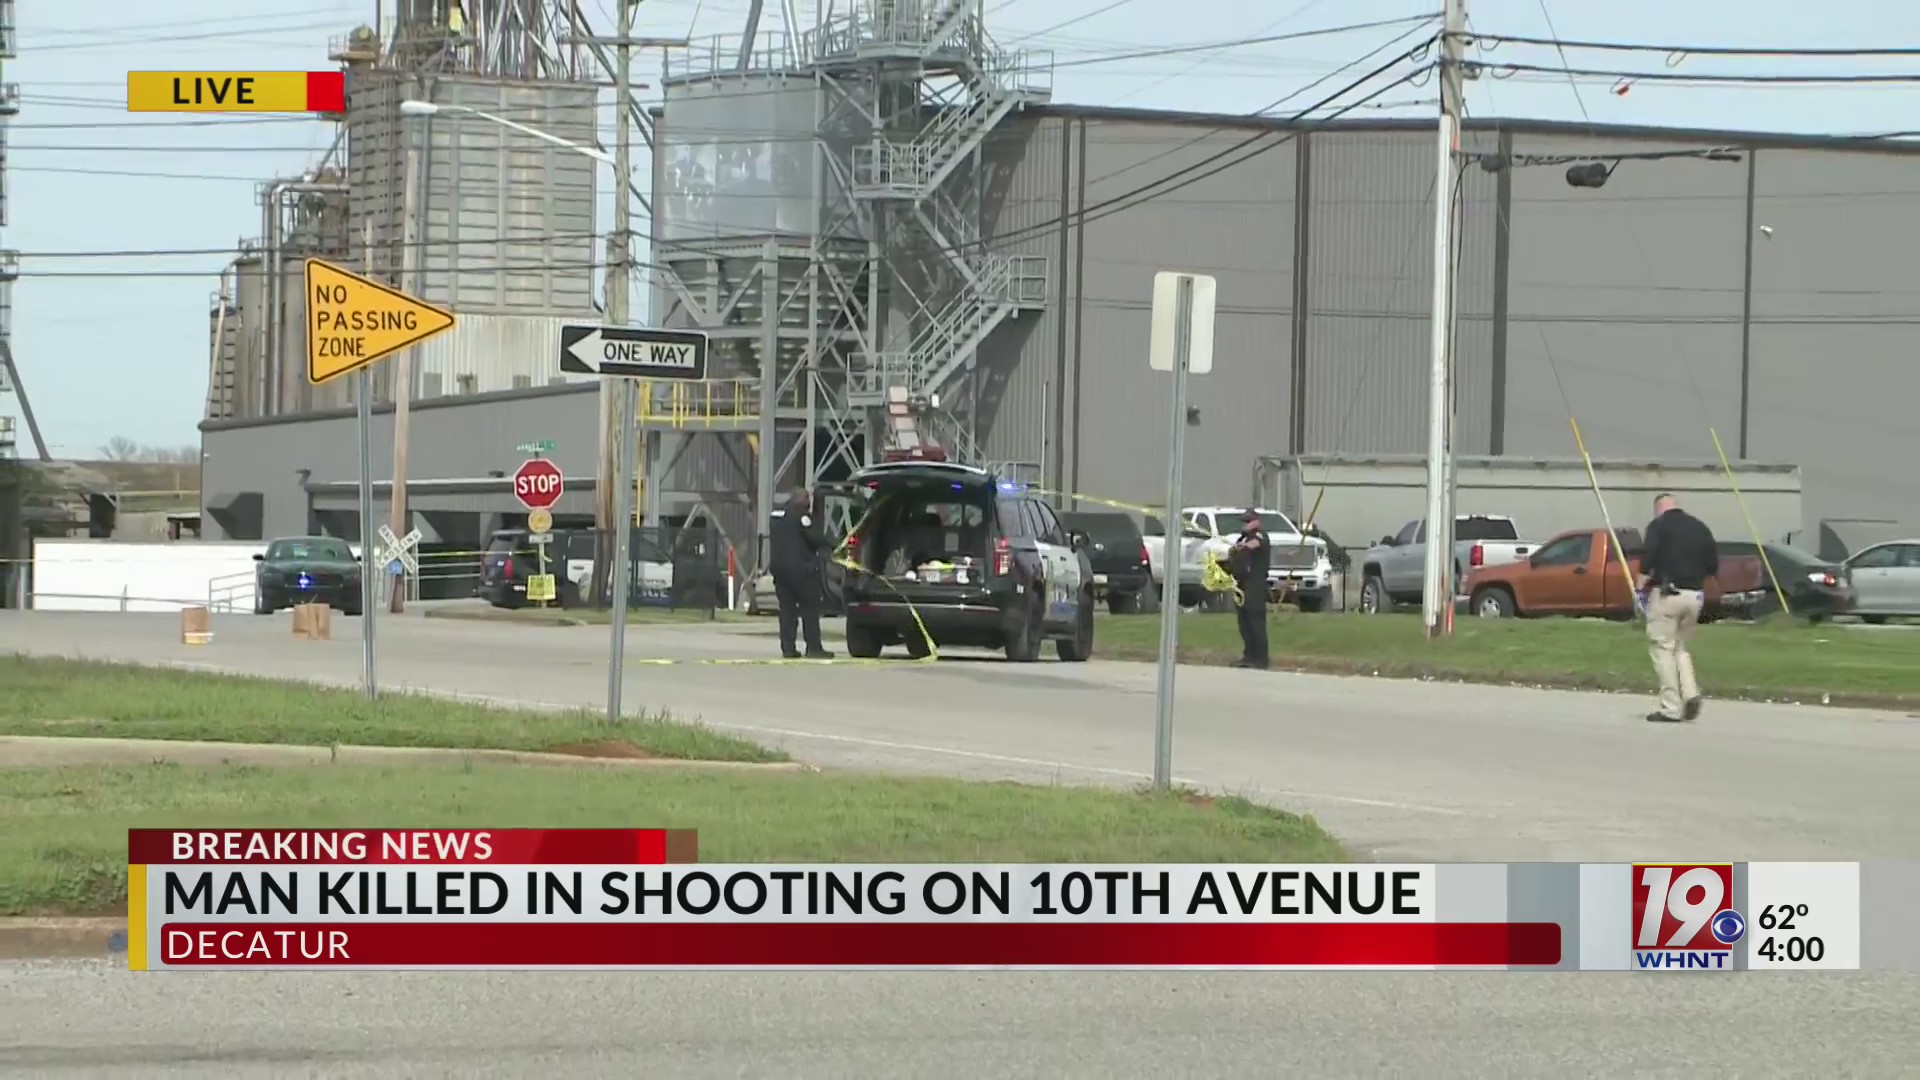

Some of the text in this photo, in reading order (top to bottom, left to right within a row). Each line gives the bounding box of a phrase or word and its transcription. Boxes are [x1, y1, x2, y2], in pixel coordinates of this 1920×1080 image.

[316, 284, 347, 305] NO
[317, 310, 418, 331] PASSING
[318, 336, 367, 358] ZONE
[603, 341, 690, 365] ONE WAY
[518, 474, 560, 495] STOP
